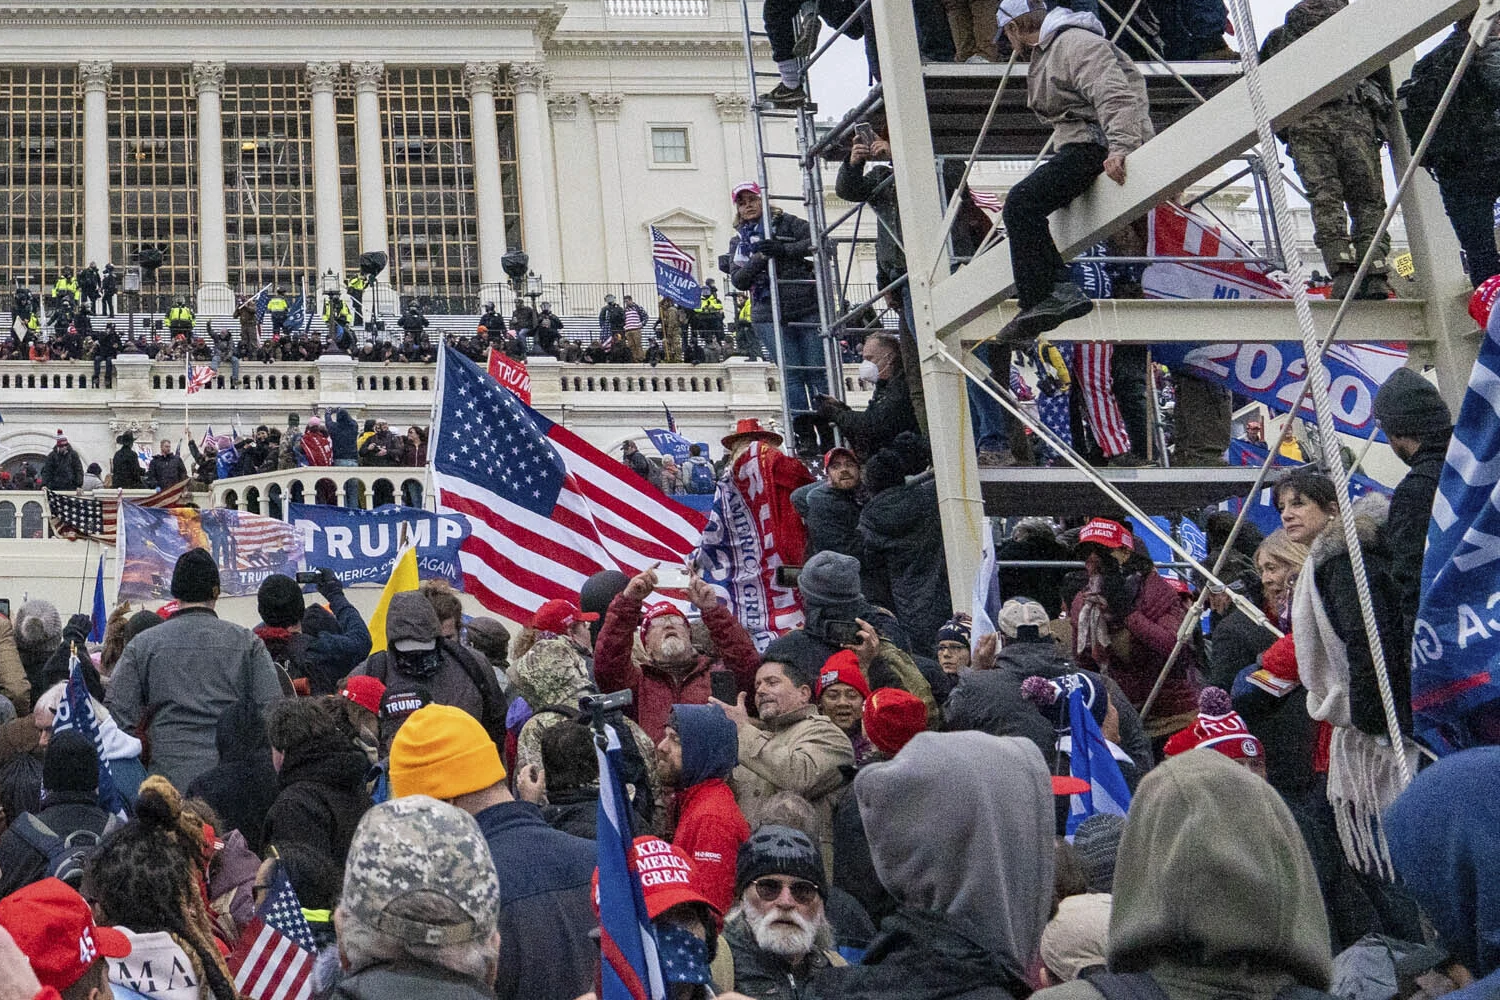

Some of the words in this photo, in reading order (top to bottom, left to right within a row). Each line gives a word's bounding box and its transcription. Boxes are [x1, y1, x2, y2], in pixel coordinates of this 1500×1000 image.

[498, 360, 532, 394] TRUM
[1183, 343, 1372, 426] 2020
[295, 517, 462, 559] TRUMP
[333, 566, 378, 582] MERICA
[418, 557, 457, 580] AGAIN
[385, 699, 422, 713] TRUMP
[1244, 741, 1256, 752] 45
[635, 854, 692, 873] MERICA
[641, 869, 690, 887] GREAT
[80, 926, 97, 963] 45
